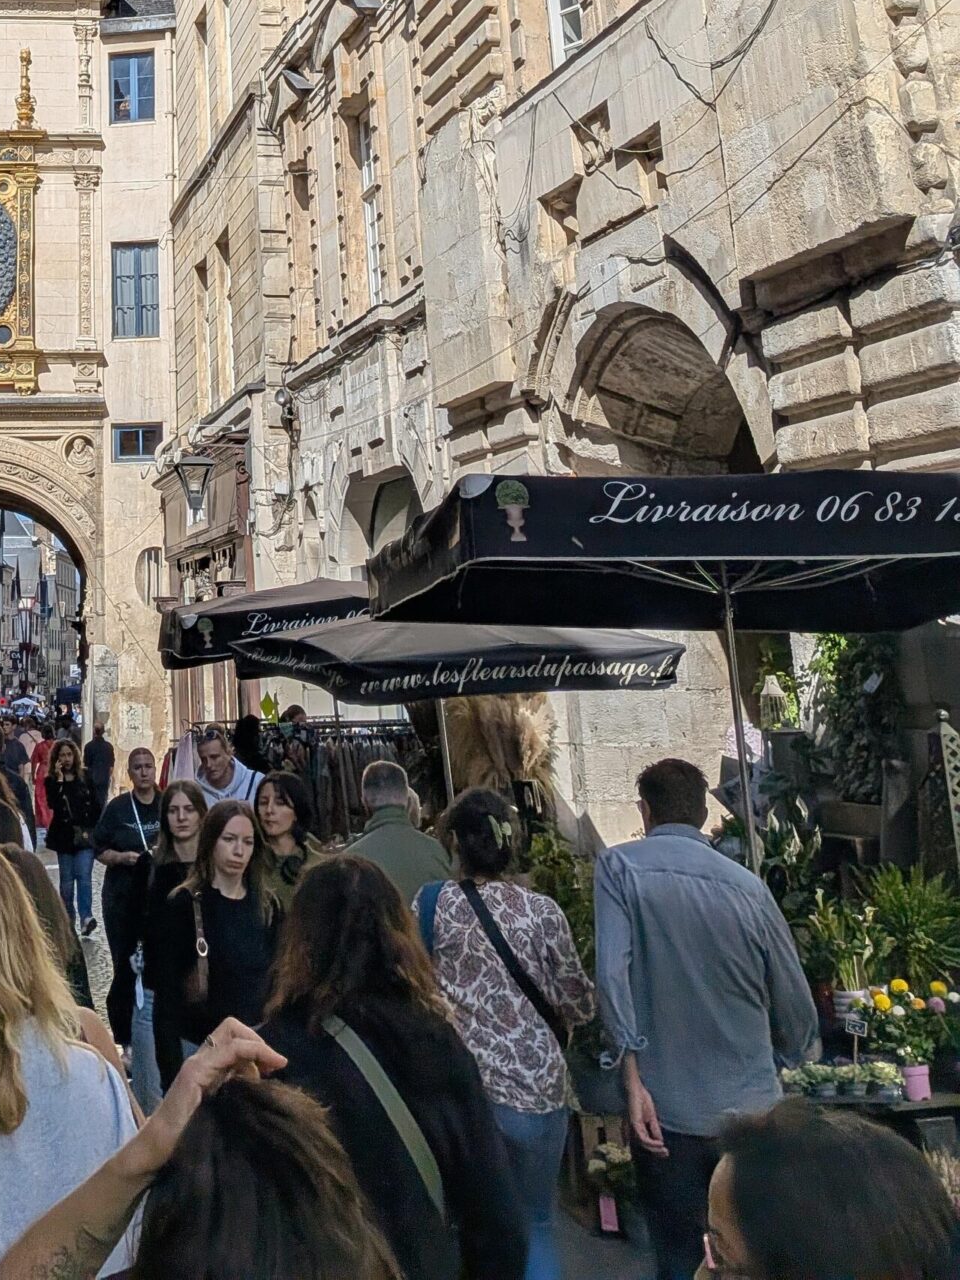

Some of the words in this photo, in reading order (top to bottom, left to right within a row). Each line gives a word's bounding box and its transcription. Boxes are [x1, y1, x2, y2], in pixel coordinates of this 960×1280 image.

[589, 481, 805, 524] Livraison
[816, 491, 874, 522] 06
[874, 491, 922, 522] 83
[241, 612, 339, 636] Livraison
